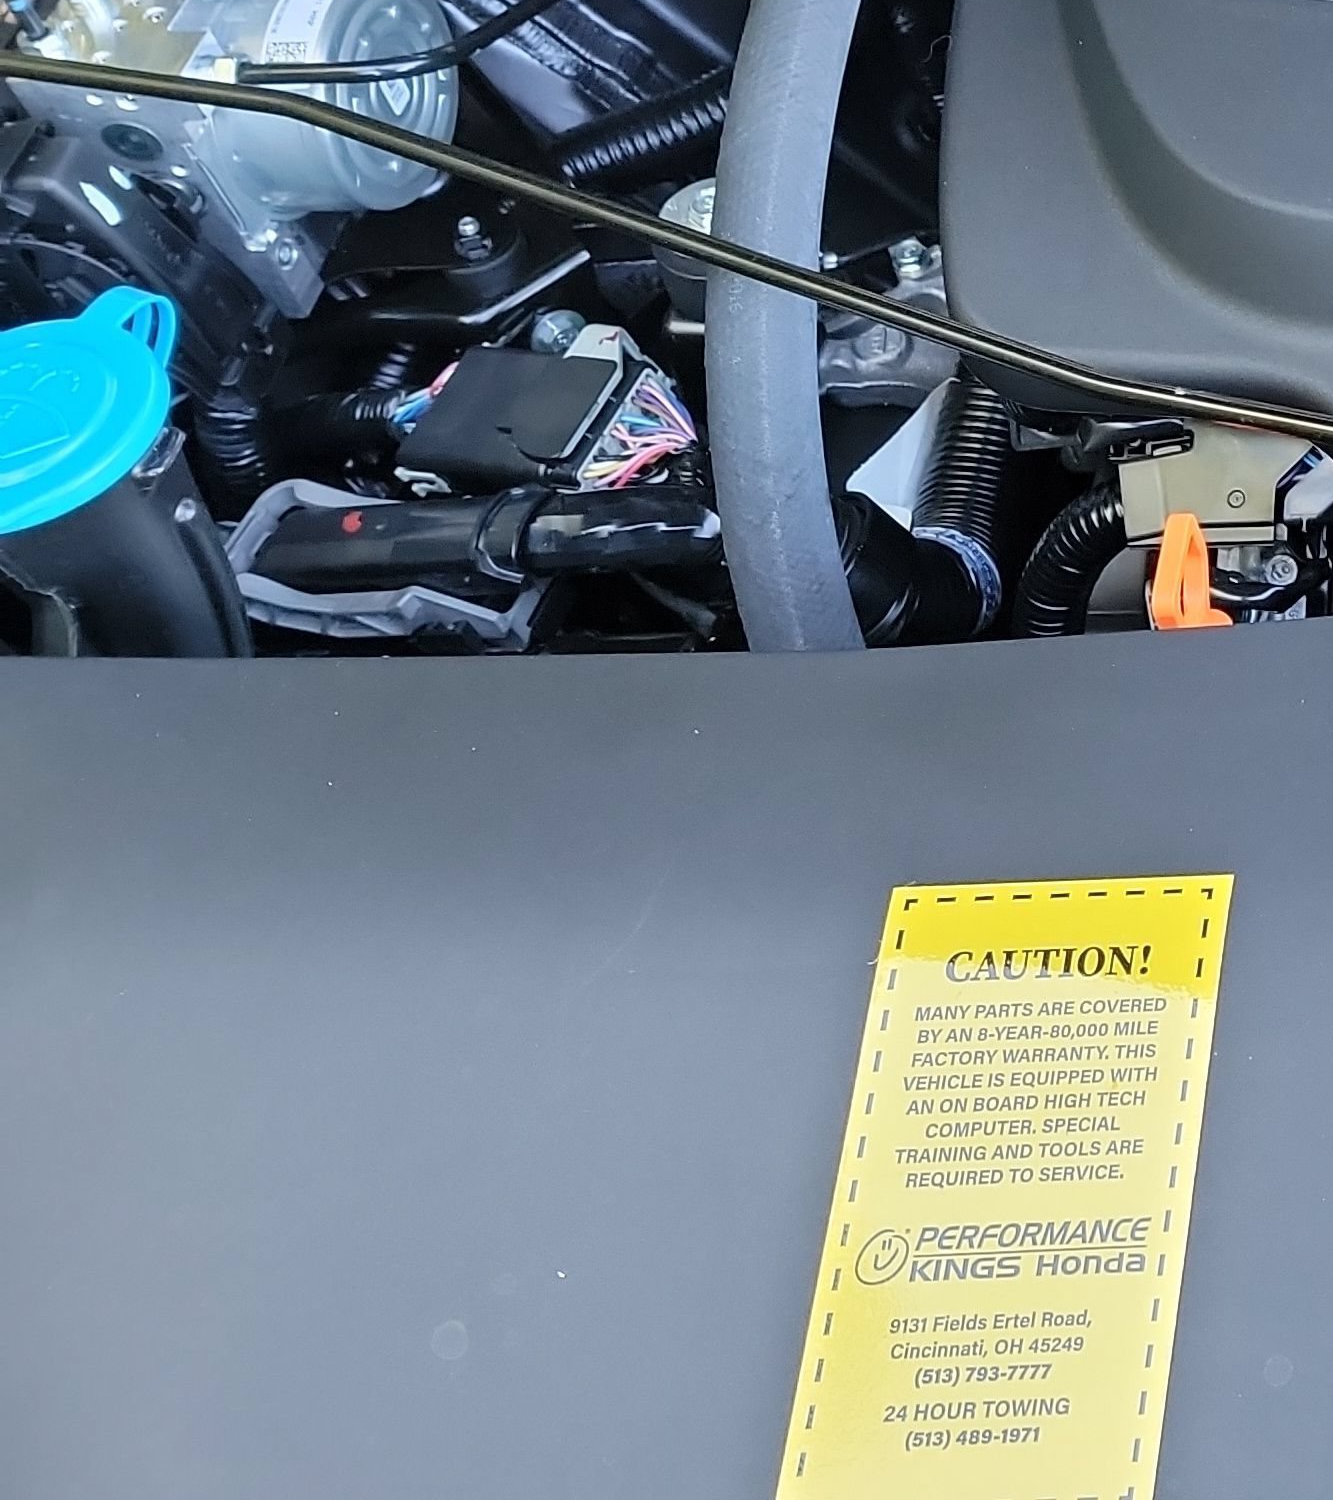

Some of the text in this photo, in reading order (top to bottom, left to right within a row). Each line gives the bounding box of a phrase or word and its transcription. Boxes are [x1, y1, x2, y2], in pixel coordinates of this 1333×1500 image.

[945, 945, 1152, 983] CAUTION!
[914, 997, 1167, 1022] MANY PARTS ARE COVERED
[917, 1021, 1159, 1044] BY AN 8-YEAR-80,000 MILE
[911, 1043, 1157, 1068] FACTORY WARRANTY. THIS
[902, 1066, 1158, 1092] VEHICLE IS EQUIPPED WITH
[905, 1090, 1146, 1116] AN ON BOARD HIGH TECH
[924, 1116, 1121, 1139] COMPUTER. SPECIAL
[895, 1138, 1144, 1165] TRAINING AND TOOLS ARE
[905, 1164, 1125, 1189] REQUIRED TO SERVICE.
[915, 1216, 1152, 1251] PERFORMANCE
[908, 1252, 1146, 1283] KINGS Honda
[889, 1309, 1092, 1334] 9131 Fields Ertel Road,
[890, 1336, 1084, 1360] Cincinnati, OH 45249
[914, 1364, 1053, 1389] (513) 793-7777
[883, 1397, 1071, 1423] 24 HOUR TOWING
[905, 1427, 1041, 1452] (513) 489-1971
